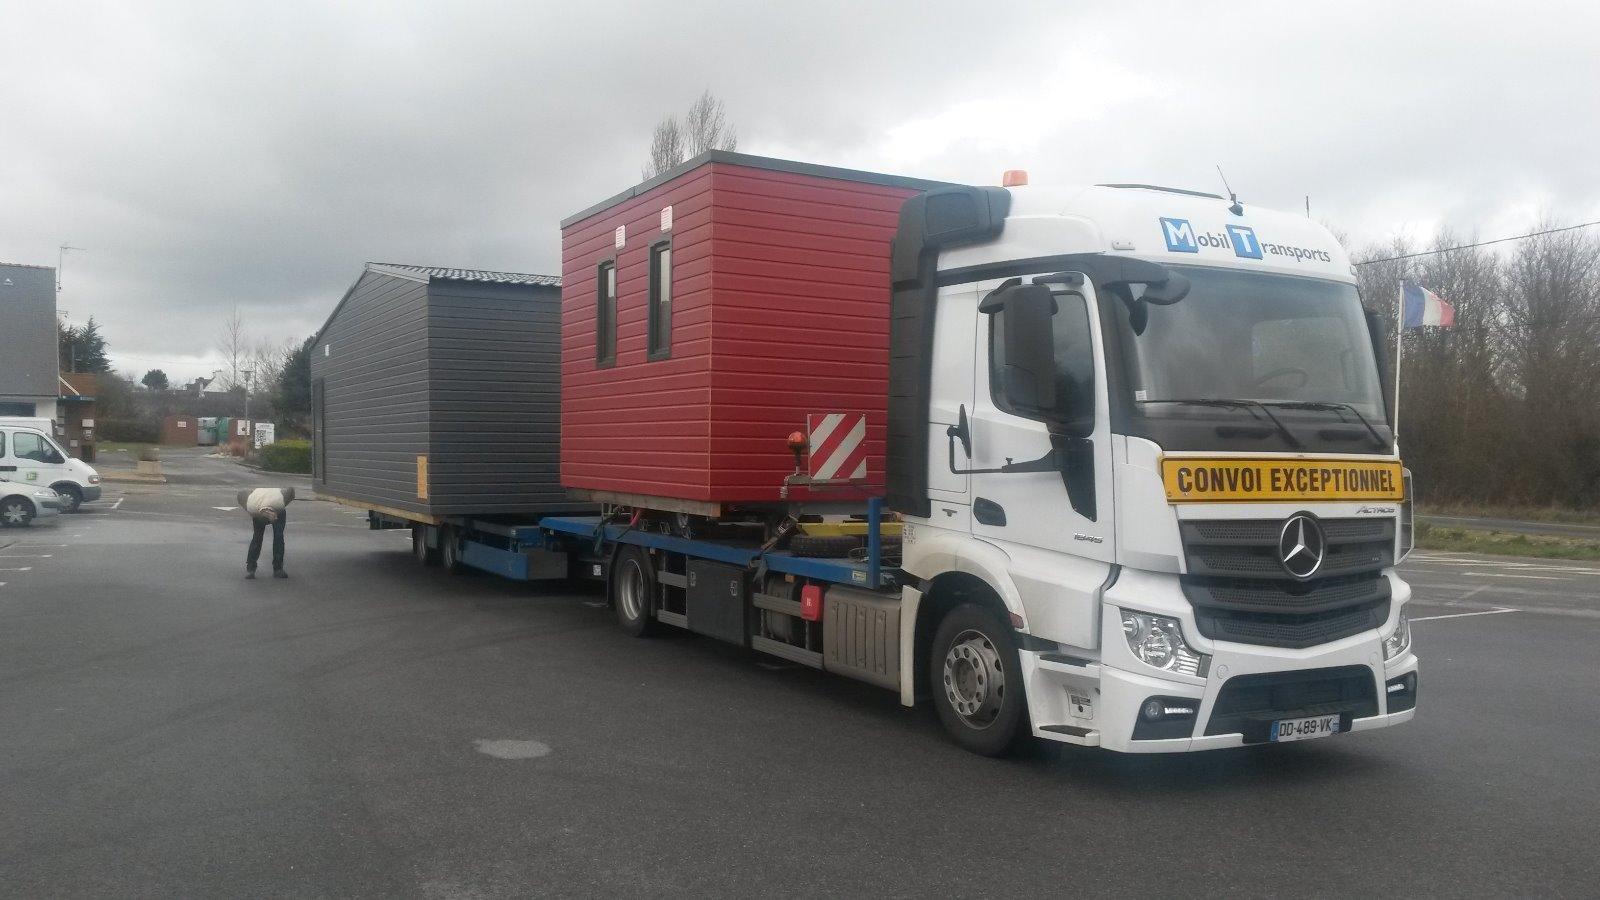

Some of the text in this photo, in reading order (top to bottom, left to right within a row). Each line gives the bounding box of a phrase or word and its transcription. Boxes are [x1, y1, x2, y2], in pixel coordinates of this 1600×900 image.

[1163, 219, 1331, 263] Mobil Transports
[1177, 467, 1396, 493] CONVOI EXCEPTIONNEL
[1279, 717, 1333, 737] DD-489-VK
